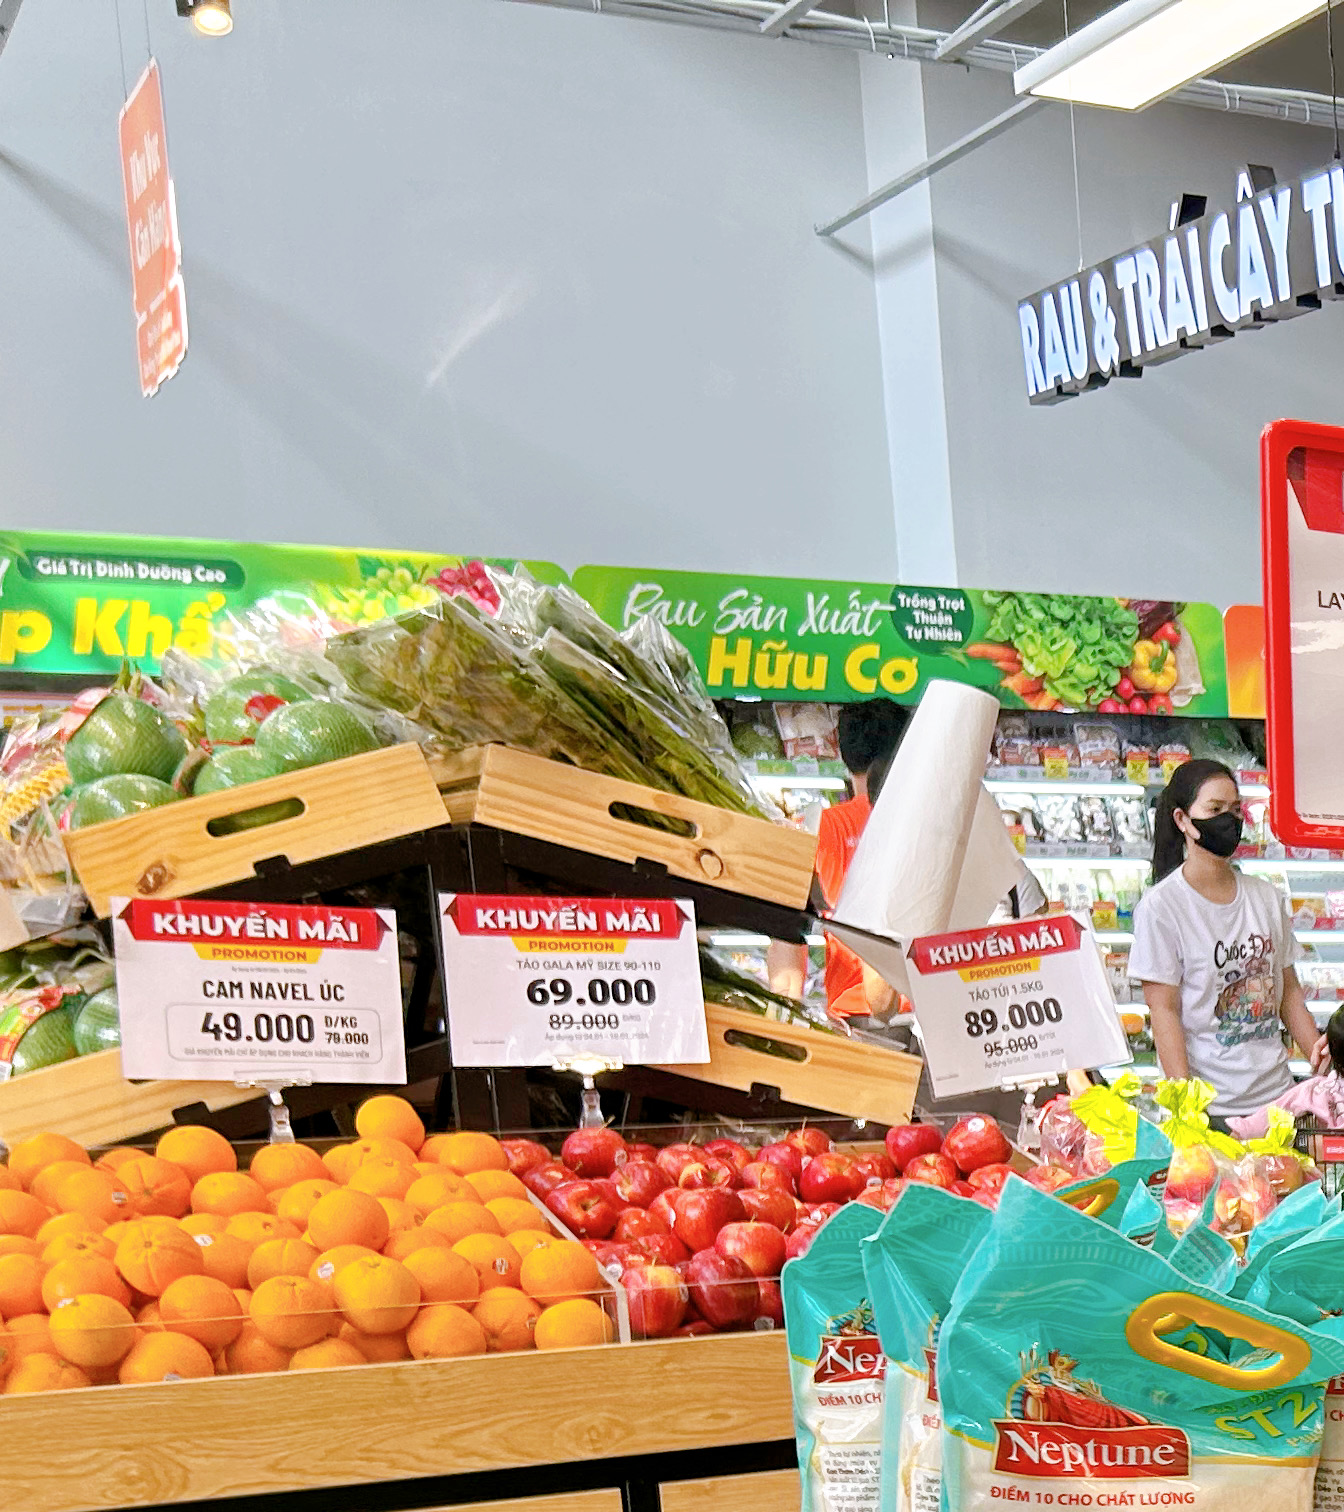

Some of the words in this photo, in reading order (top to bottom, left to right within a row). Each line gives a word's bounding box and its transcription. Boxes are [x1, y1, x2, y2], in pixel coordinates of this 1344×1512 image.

[1018, 280, 1088, 397] RAU
[1088, 271, 1119, 378] &
[1116, 202, 1208, 357] TRÁI
[1208, 171, 1291, 324] CÂY
[195, 566, 226, 582] Cao
[622, 583, 707, 635] Rau
[714, 589, 789, 634] Sản
[798, 590, 896, 637] Xuất
[707, 637, 828, 691] Hữu
[845, 644, 919, 694] Cơ
[154, 910, 288, 940] KHUYẾN
[300, 916, 359, 942] MÃI
[476, 904, 597, 931] KHUYẾN
[607, 908, 661, 932] MÃI
[212, 948, 307, 961] PROMOTION
[929, 932, 1015, 966] KHUYẾN
[1022, 926, 1064, 952] MÃI
[203, 980, 244, 998] CAM
[250, 982, 314, 1000] NAVEL
[320, 980, 344, 1001] ÚC
[527, 979, 656, 1006] 69.000
[201, 1012, 314, 1042] 49.000
[965, 998, 1062, 1037] 89.000
[1005, 1430, 1175, 1472] Neptune
[991, 1486, 1031, 1504] ĐIỂM
[1036, 1491, 1053, 1504] 10
[1058, 1491, 1093, 1505] CHO
[1098, 1486, 1137, 1507] CHẤT
[1140, 1489, 1195, 1508] LƯỢNG
